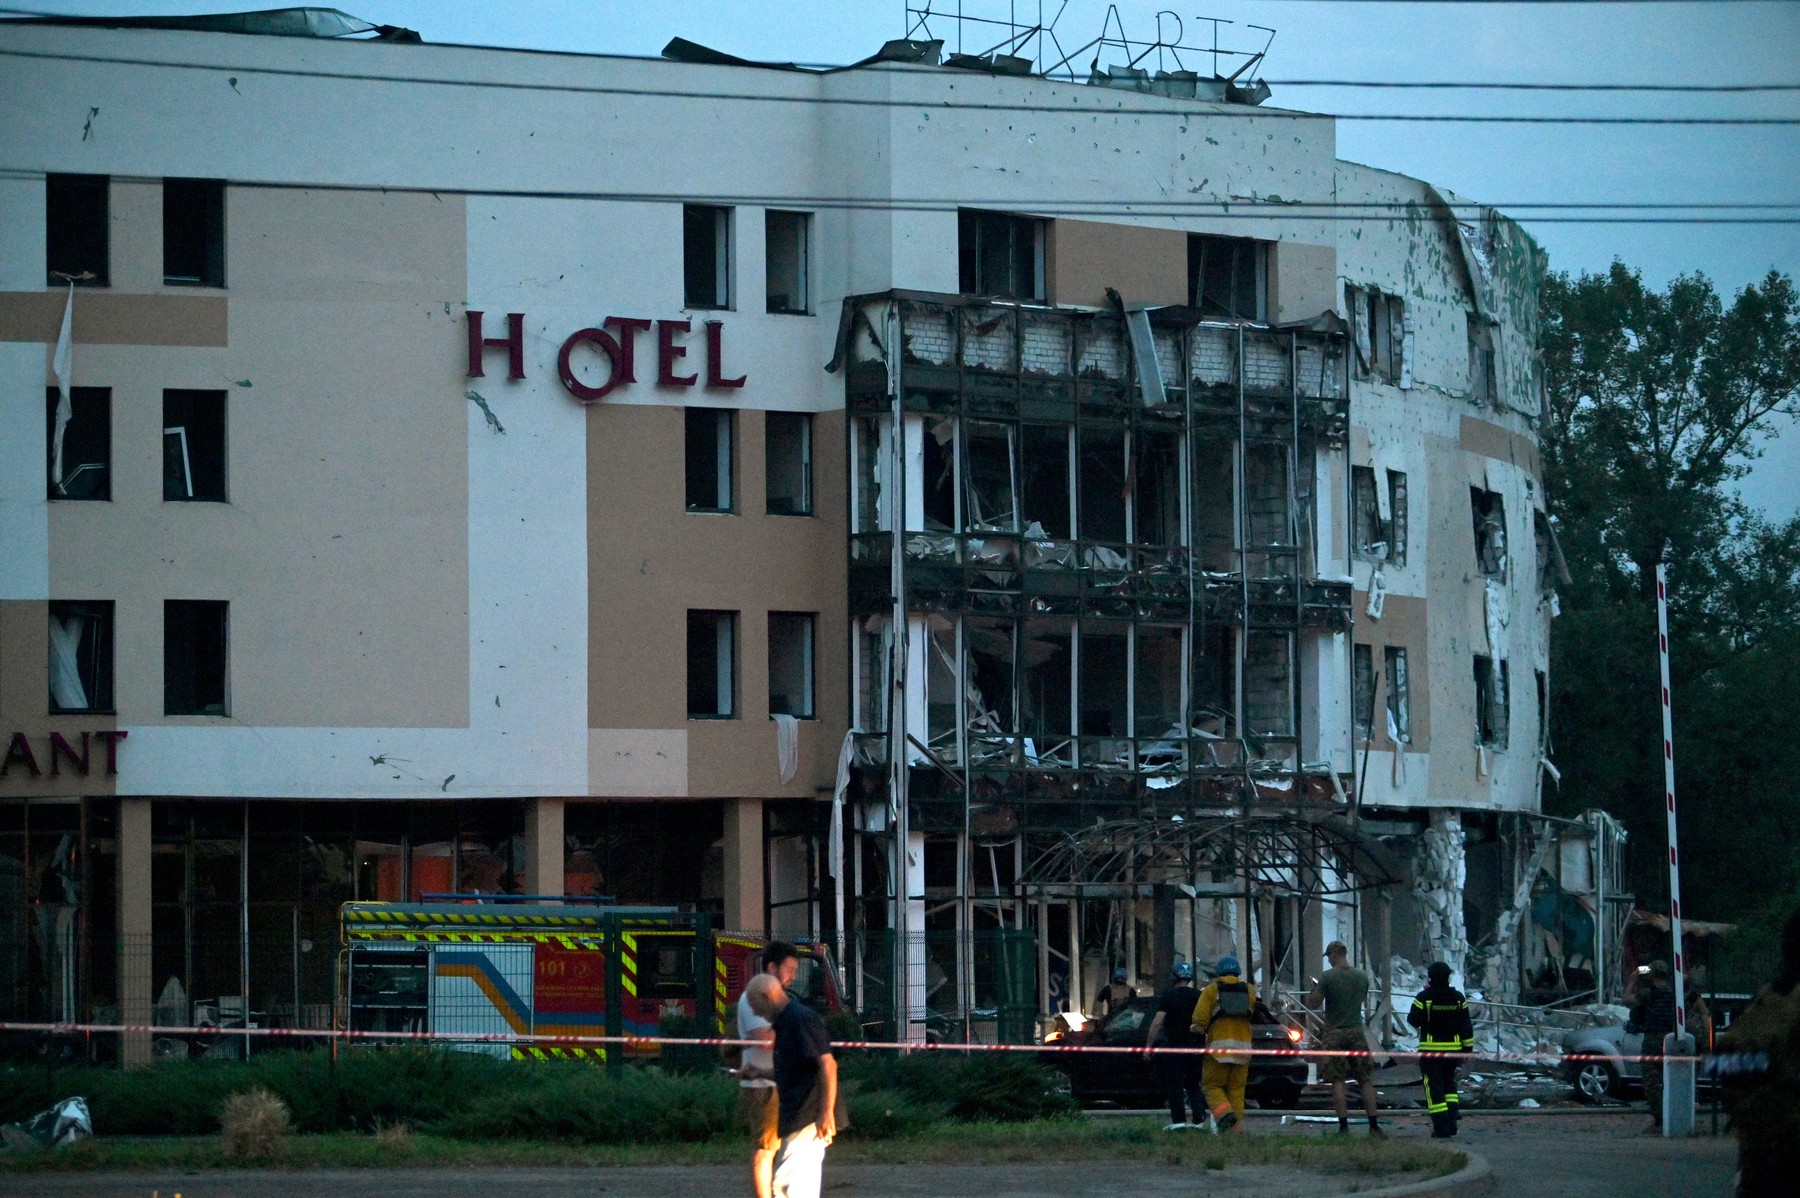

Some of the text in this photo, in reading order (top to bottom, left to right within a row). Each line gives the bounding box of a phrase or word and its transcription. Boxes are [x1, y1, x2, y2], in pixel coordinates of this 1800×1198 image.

[465, 310, 747, 401] HOTEL
[0, 730, 128, 777] ANT
[538, 960, 566, 977] 101
